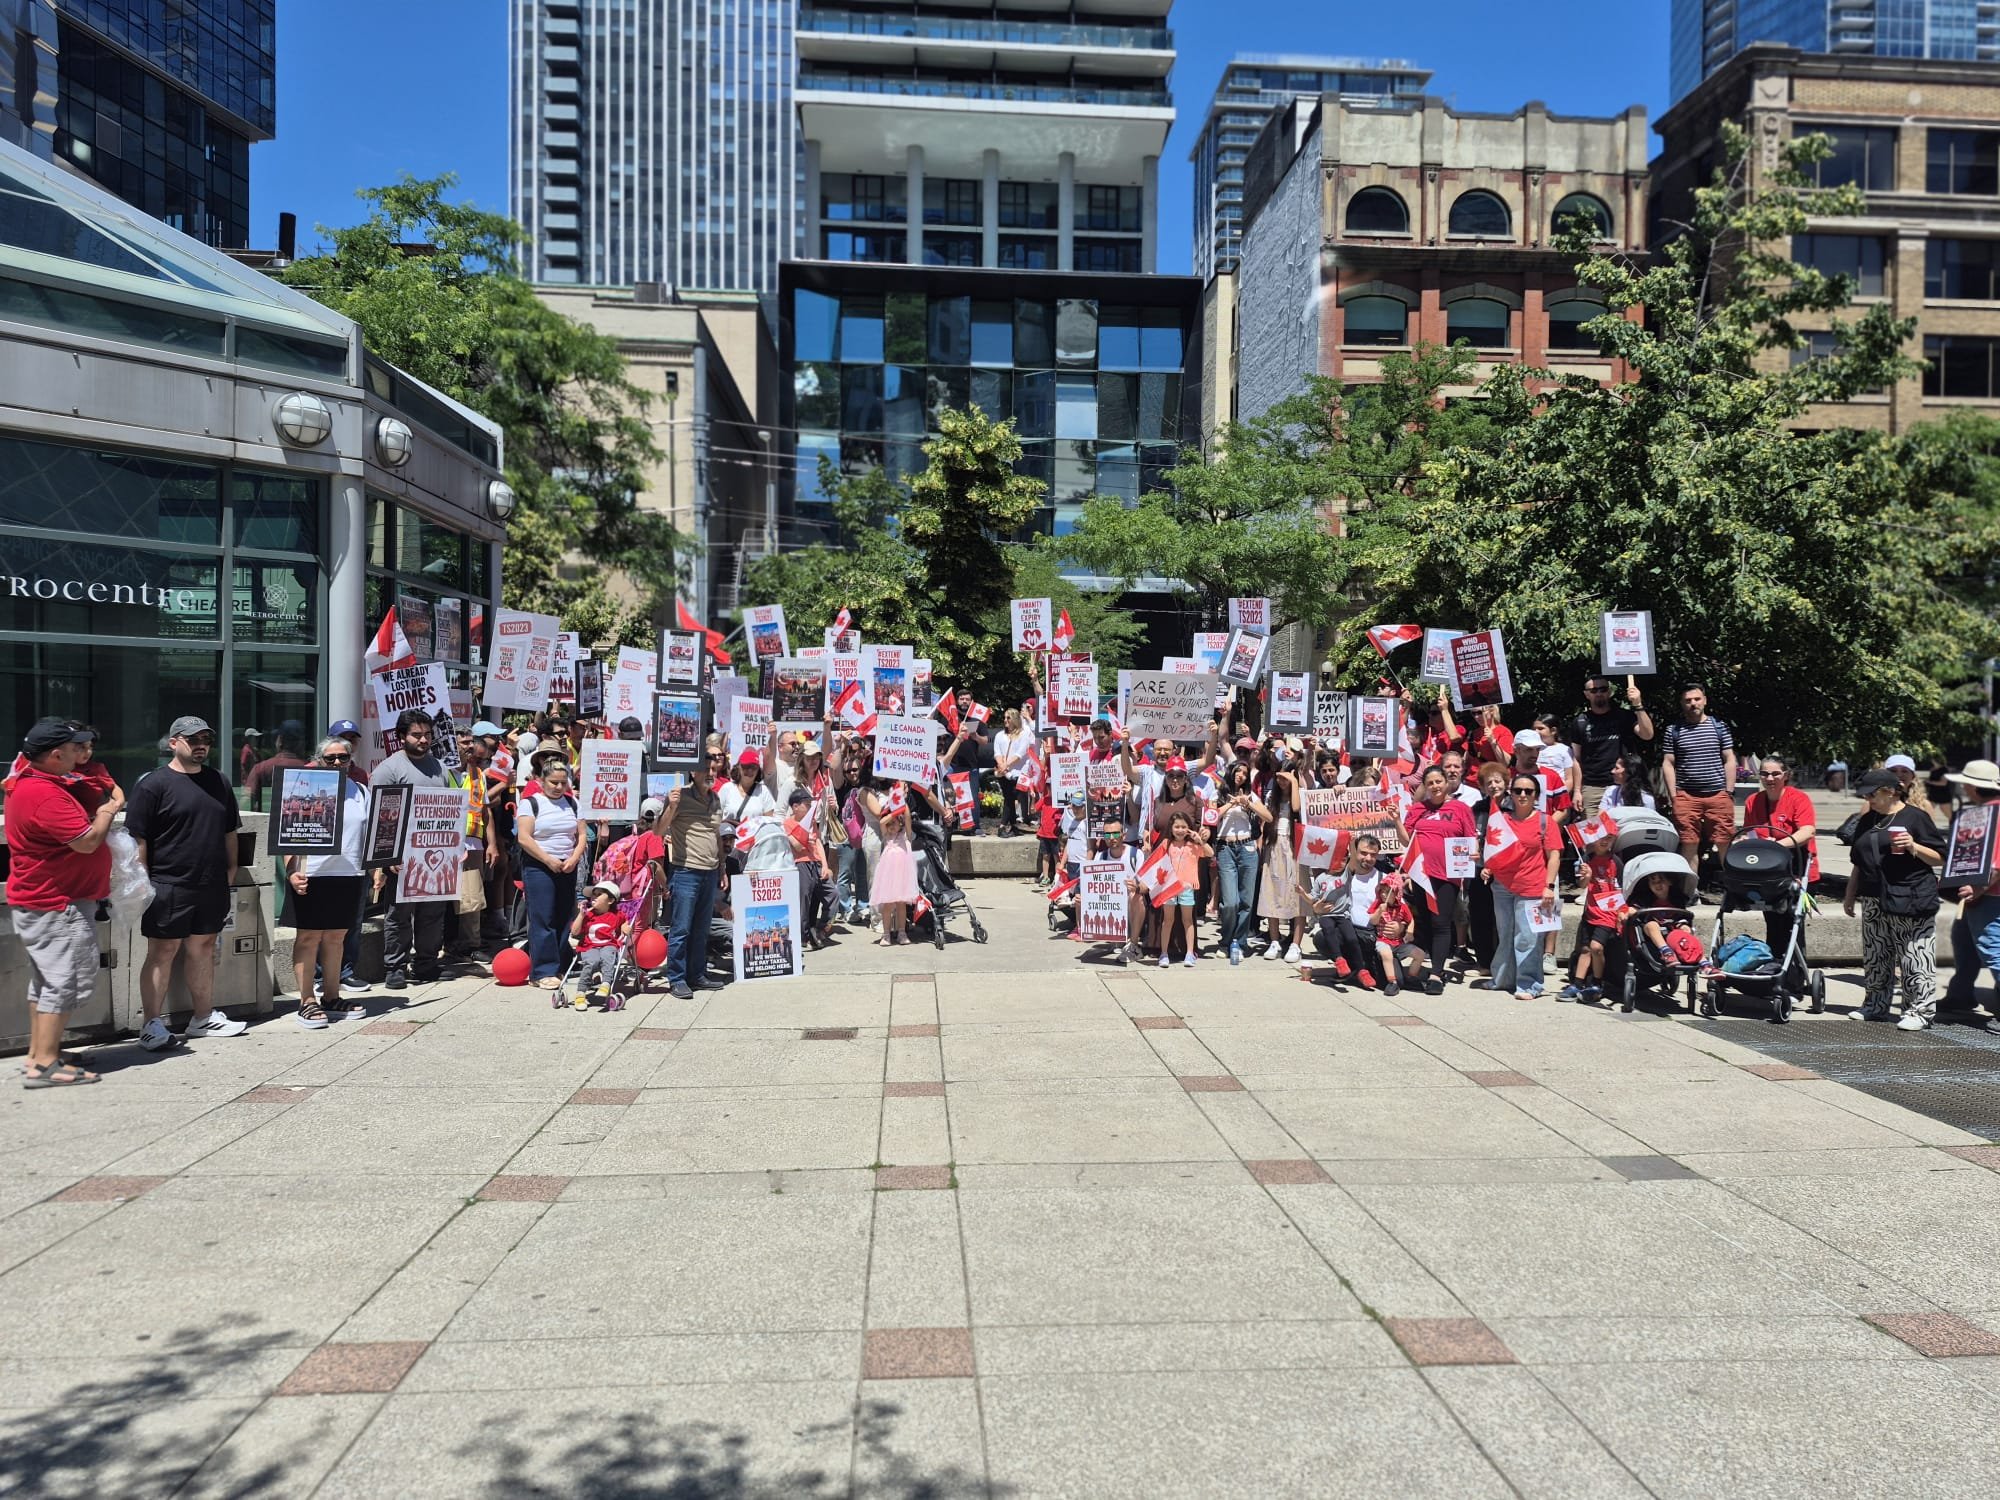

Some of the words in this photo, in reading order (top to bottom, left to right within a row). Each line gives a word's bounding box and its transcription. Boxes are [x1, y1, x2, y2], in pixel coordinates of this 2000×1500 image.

[1238, 610, 1263, 624] TS2023
[502, 623, 529, 634] TS2023
[878, 659, 900, 667] TS2023
[381, 671, 394, 683] WE
[397, 665, 429, 679] ALREADY
[391, 679, 409, 692] LOST
[411, 676, 426, 688] OUR
[1133, 680, 1167, 694] ARE
[385, 686, 436, 712] HOMES
[1317, 693, 1344, 702] WORK
[1177, 698, 1209, 709] FUTURES
[1318, 703, 1341, 713] PAY
[745, 714, 758, 722] HAS
[1131, 708, 1138, 717] A
[1142, 709, 1168, 719] GAME
[1321, 715, 1345, 724] STAY
[890, 723, 898, 732] LE
[899, 724, 926, 734] CANADA
[1142, 723, 1155, 734] TO
[1312, 727, 1340, 737] 2023
[745, 734, 767, 746] DATE
[914, 738, 923, 746] DE
[879, 747, 930, 760] FRANCOPHONES
[889, 761, 896, 769] JE
[898, 762, 911, 771] SUIS
[414, 794, 463, 805] HUMANITARIAN
[1308, 793, 1322, 803] WE
[1347, 791, 1370, 800] BUILT
[414, 807, 461, 818] EXTENSIONS
[1308, 804, 1330, 816] OUR
[1333, 802, 1362, 814] LIVES
[417, 820, 436, 830] MUST
[437, 820, 456, 830] APPLY
[1382, 828, 1397, 838] NOT
[416, 832, 455, 846] EQUALLY.
[752, 888, 781, 901] TS2023
